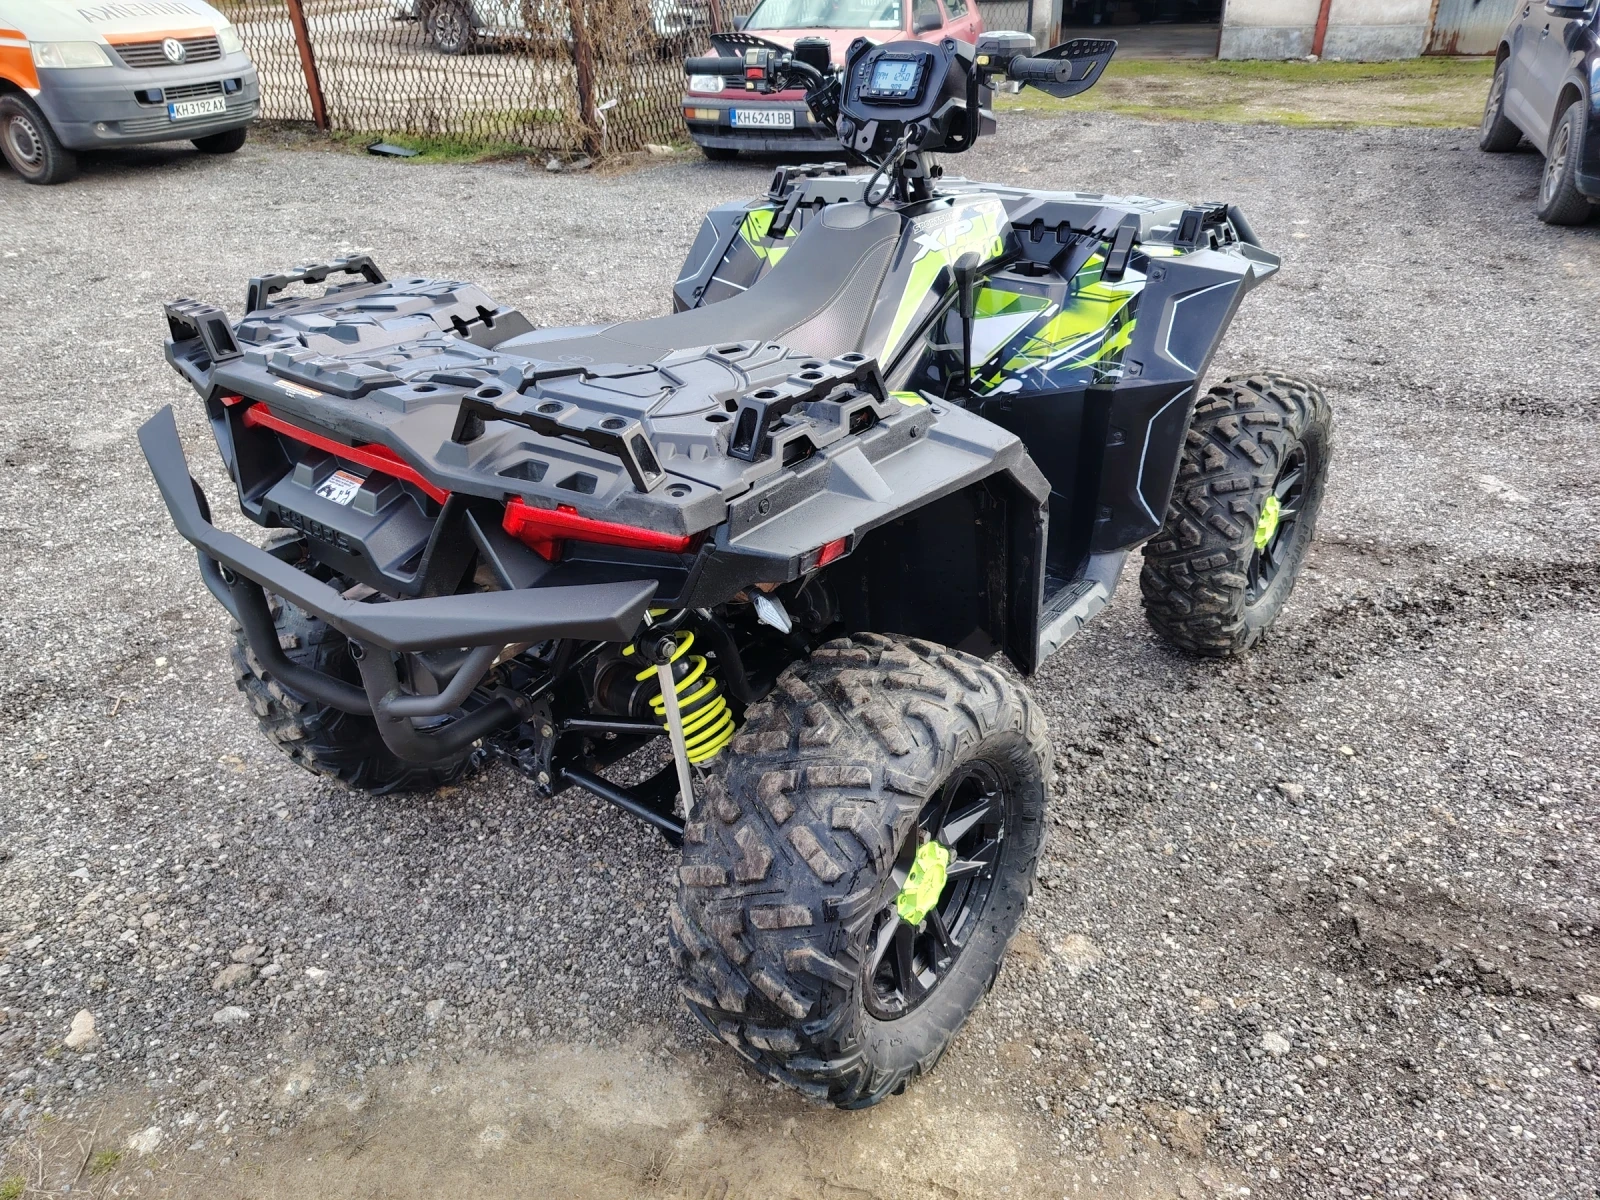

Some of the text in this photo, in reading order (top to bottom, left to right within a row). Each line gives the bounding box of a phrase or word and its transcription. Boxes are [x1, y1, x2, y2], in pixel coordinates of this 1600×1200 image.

[176, 98, 225, 117] KH 3192 AX
[737, 111, 791, 125] KH 6241 BB
[909, 219, 974, 264] XP
